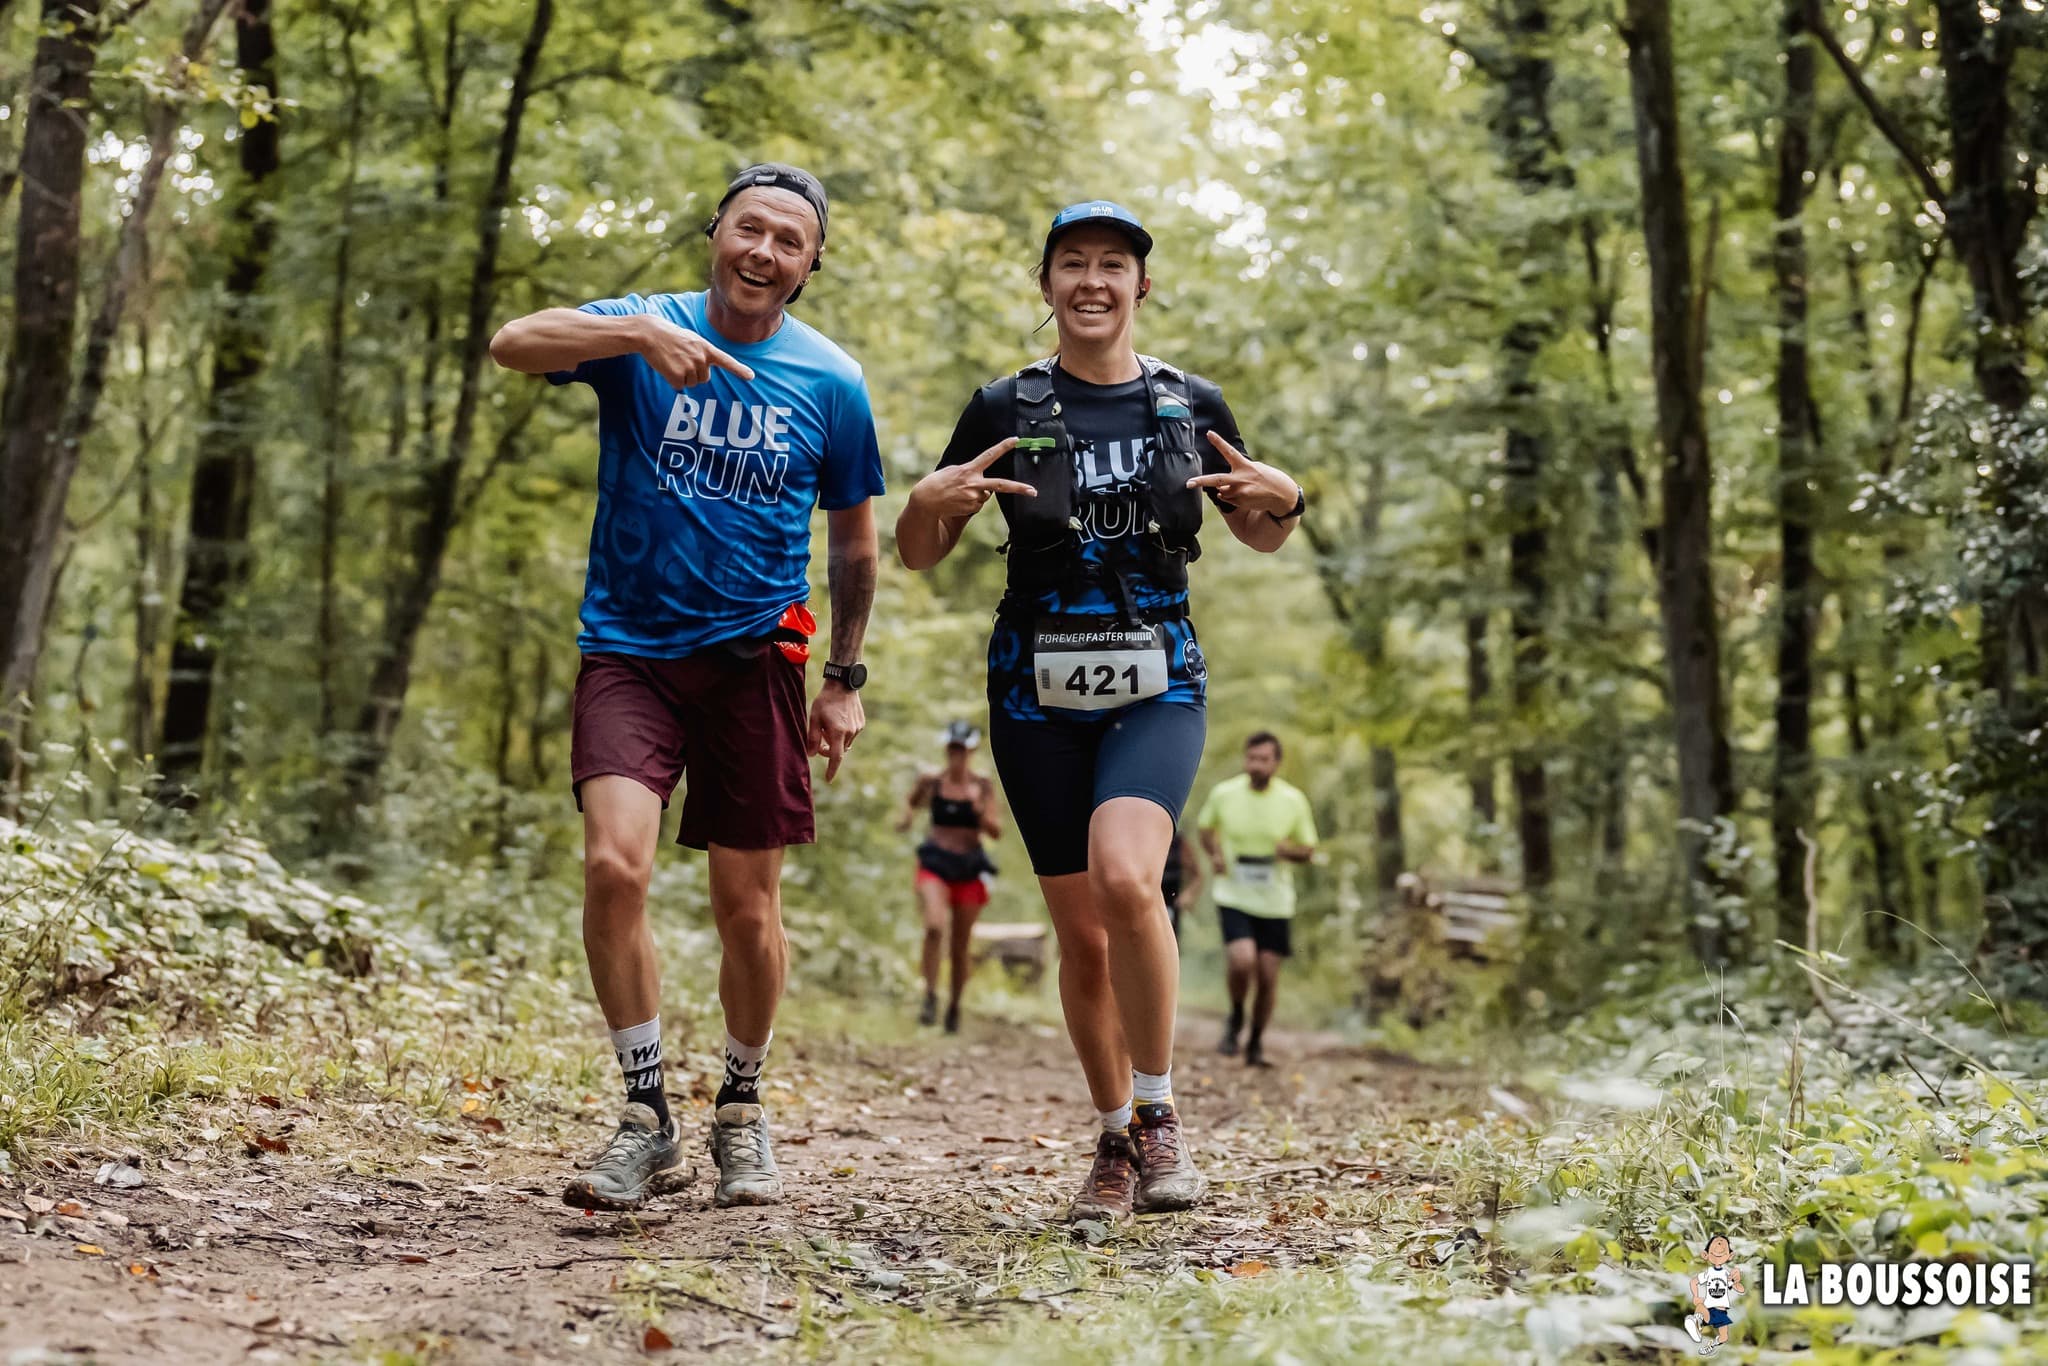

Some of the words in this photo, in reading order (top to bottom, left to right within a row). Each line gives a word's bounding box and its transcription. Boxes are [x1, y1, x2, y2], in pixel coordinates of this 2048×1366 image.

[663, 392, 793, 452] BLUE
[656, 440, 789, 505] RUN
[1065, 664, 1139, 696] 421
